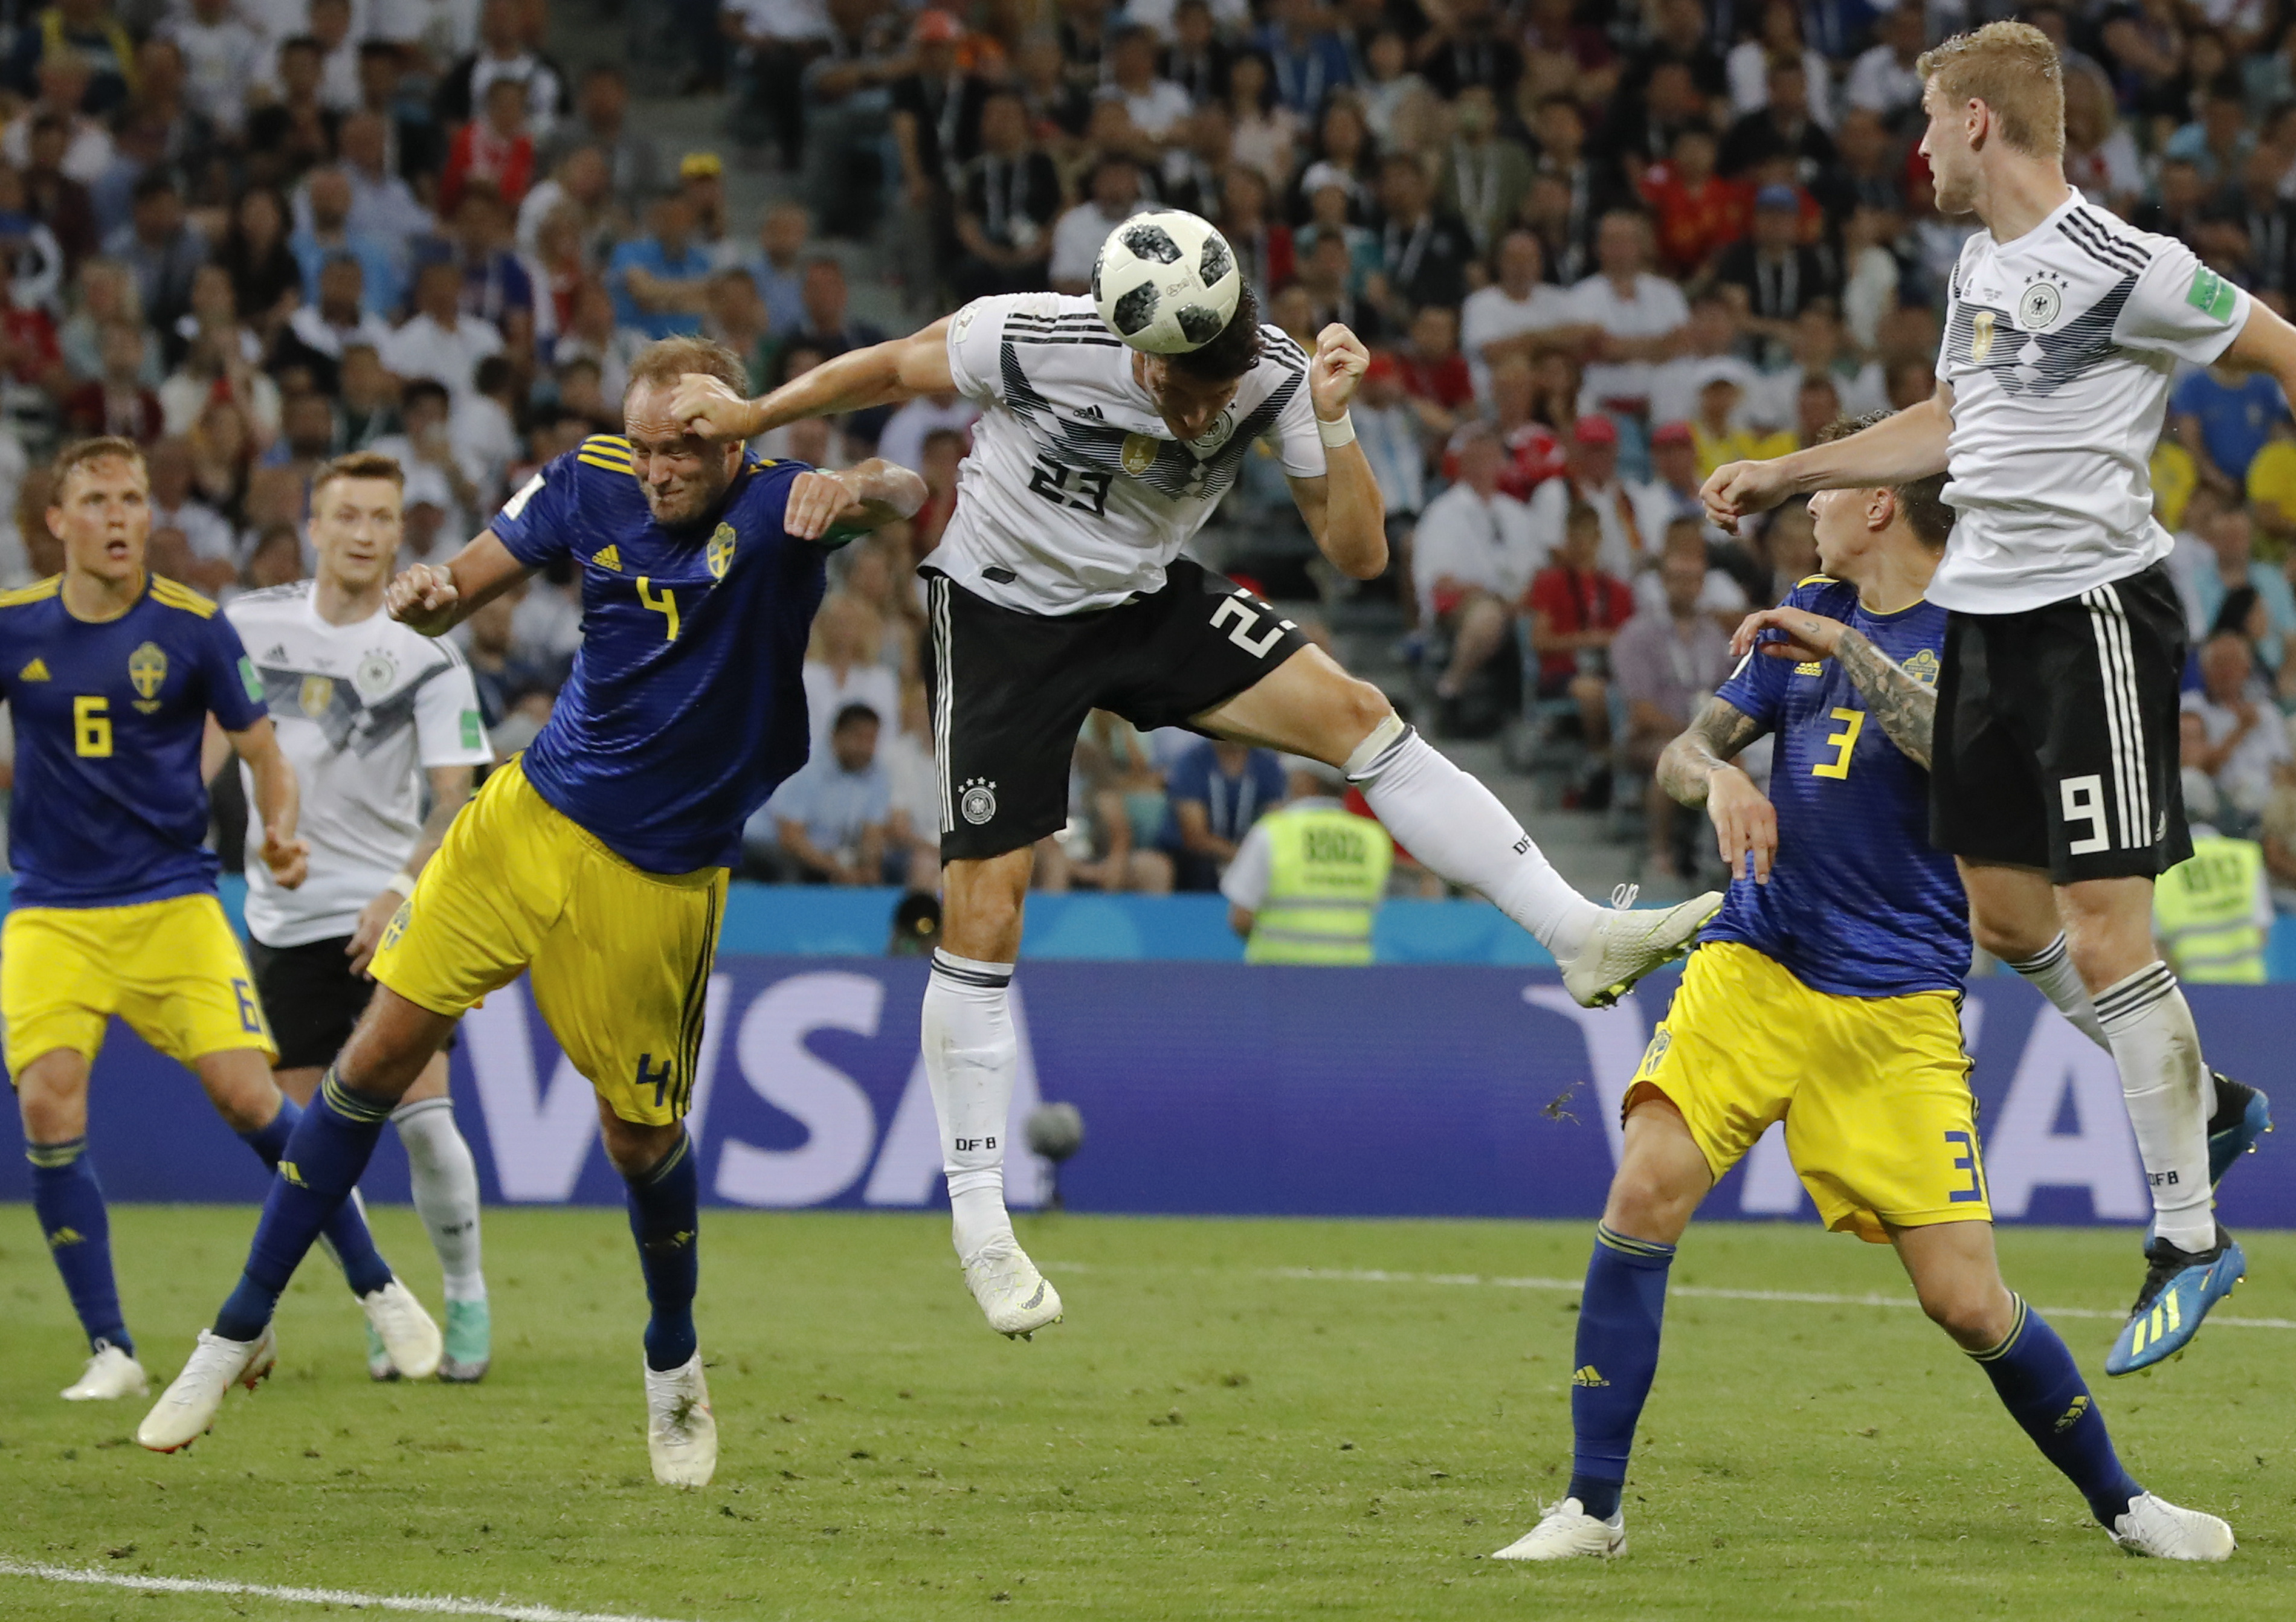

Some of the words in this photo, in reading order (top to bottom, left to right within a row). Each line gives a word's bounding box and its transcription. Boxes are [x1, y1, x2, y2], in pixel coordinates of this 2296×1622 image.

[1028, 453, 1114, 517] 23
[636, 576, 680, 642] 4
[1209, 587, 1298, 659] 2
[73, 695, 114, 758] 6
[1811, 707, 1866, 780] 3
[2060, 774, 2111, 855] 9
[231, 978, 261, 1033] 6
[636, 1053, 671, 1107] 4
[955, 1136, 996, 1151] DFB
[1944, 1131, 1982, 1203] 3
